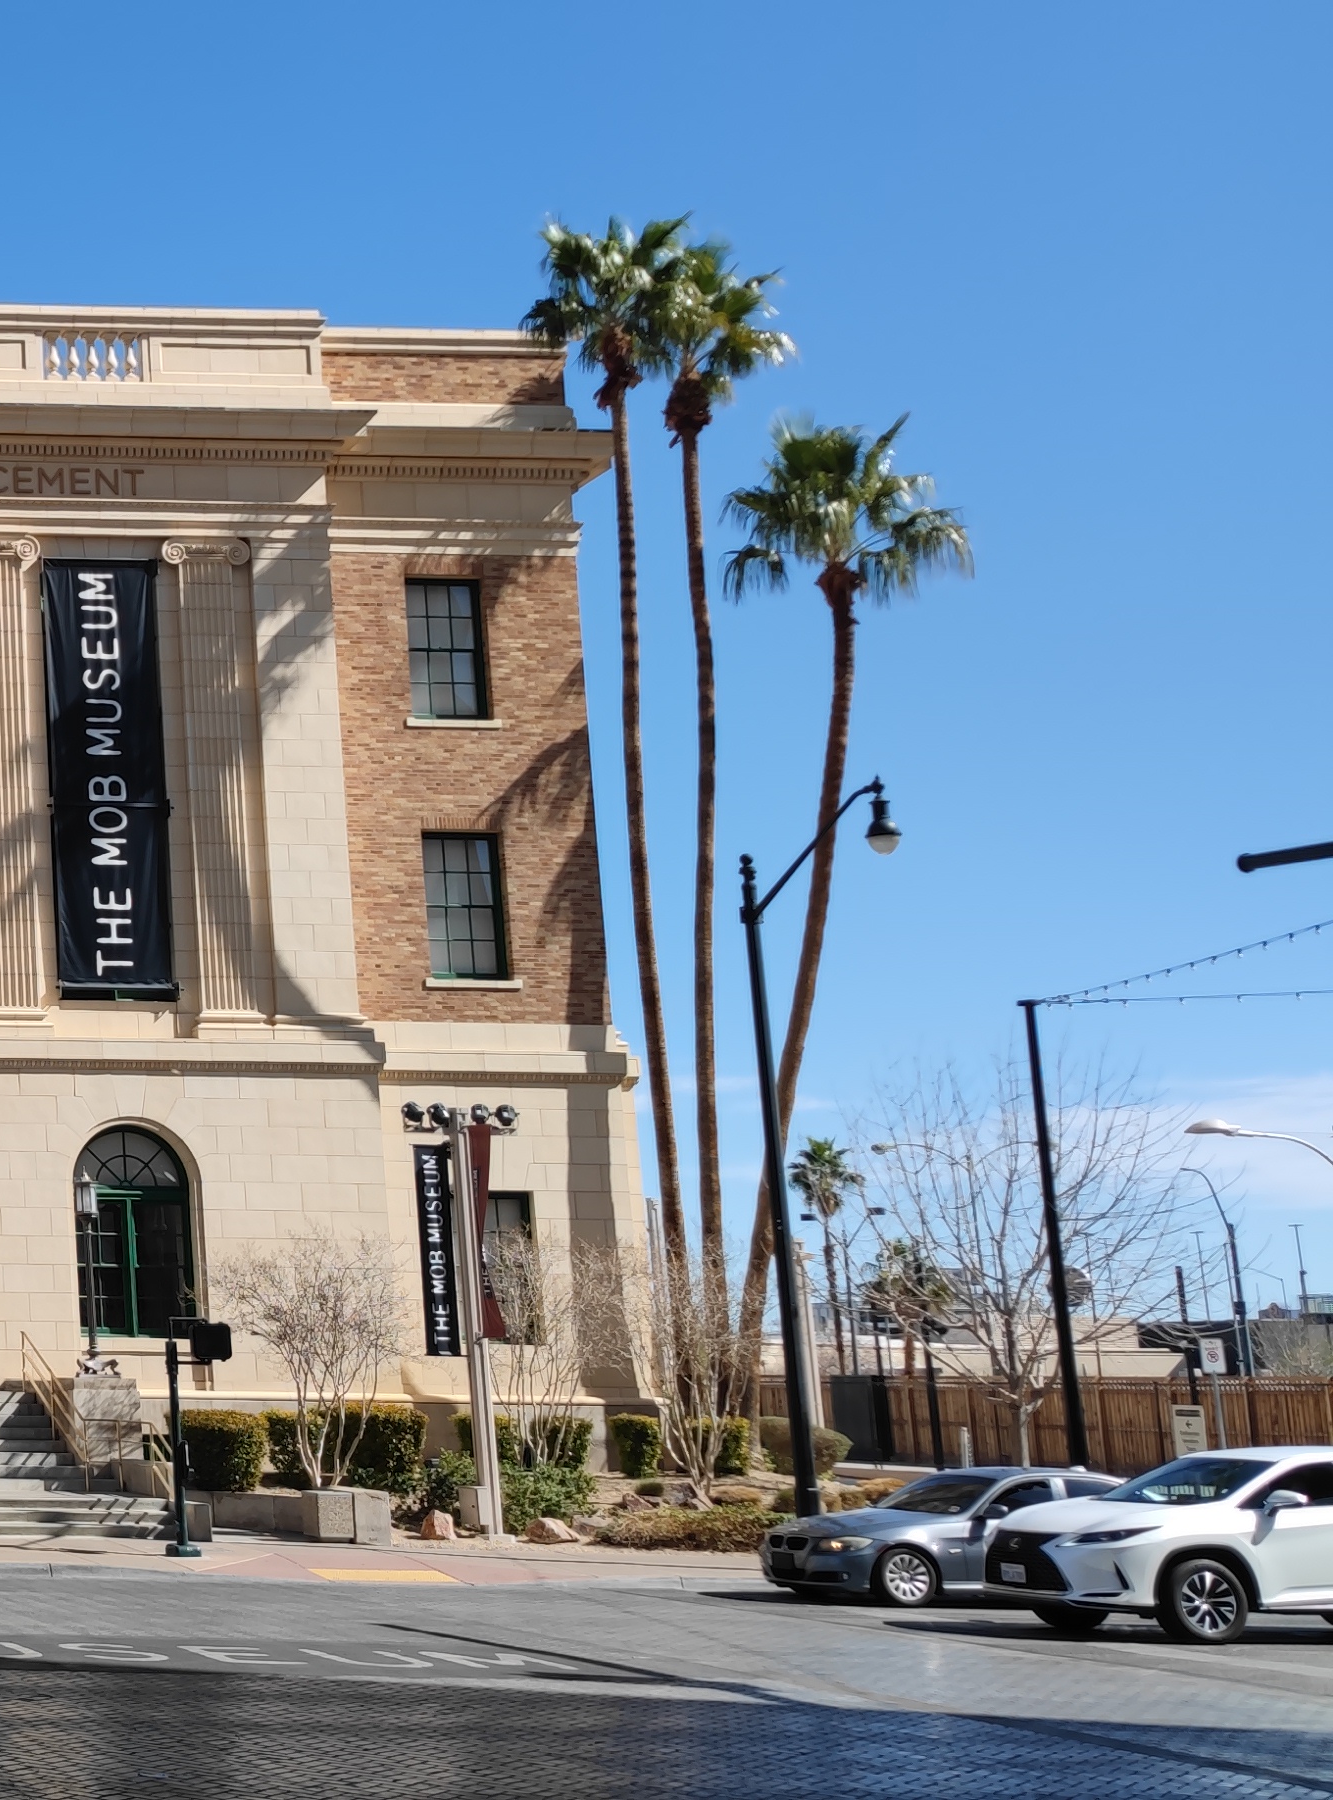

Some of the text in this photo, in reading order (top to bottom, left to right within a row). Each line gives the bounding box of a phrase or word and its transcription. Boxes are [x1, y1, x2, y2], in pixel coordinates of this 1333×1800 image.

[77, 572, 134, 977] THE MOB MUSEUM
[421, 1153, 451, 1345] THE MOB MUSEUM
